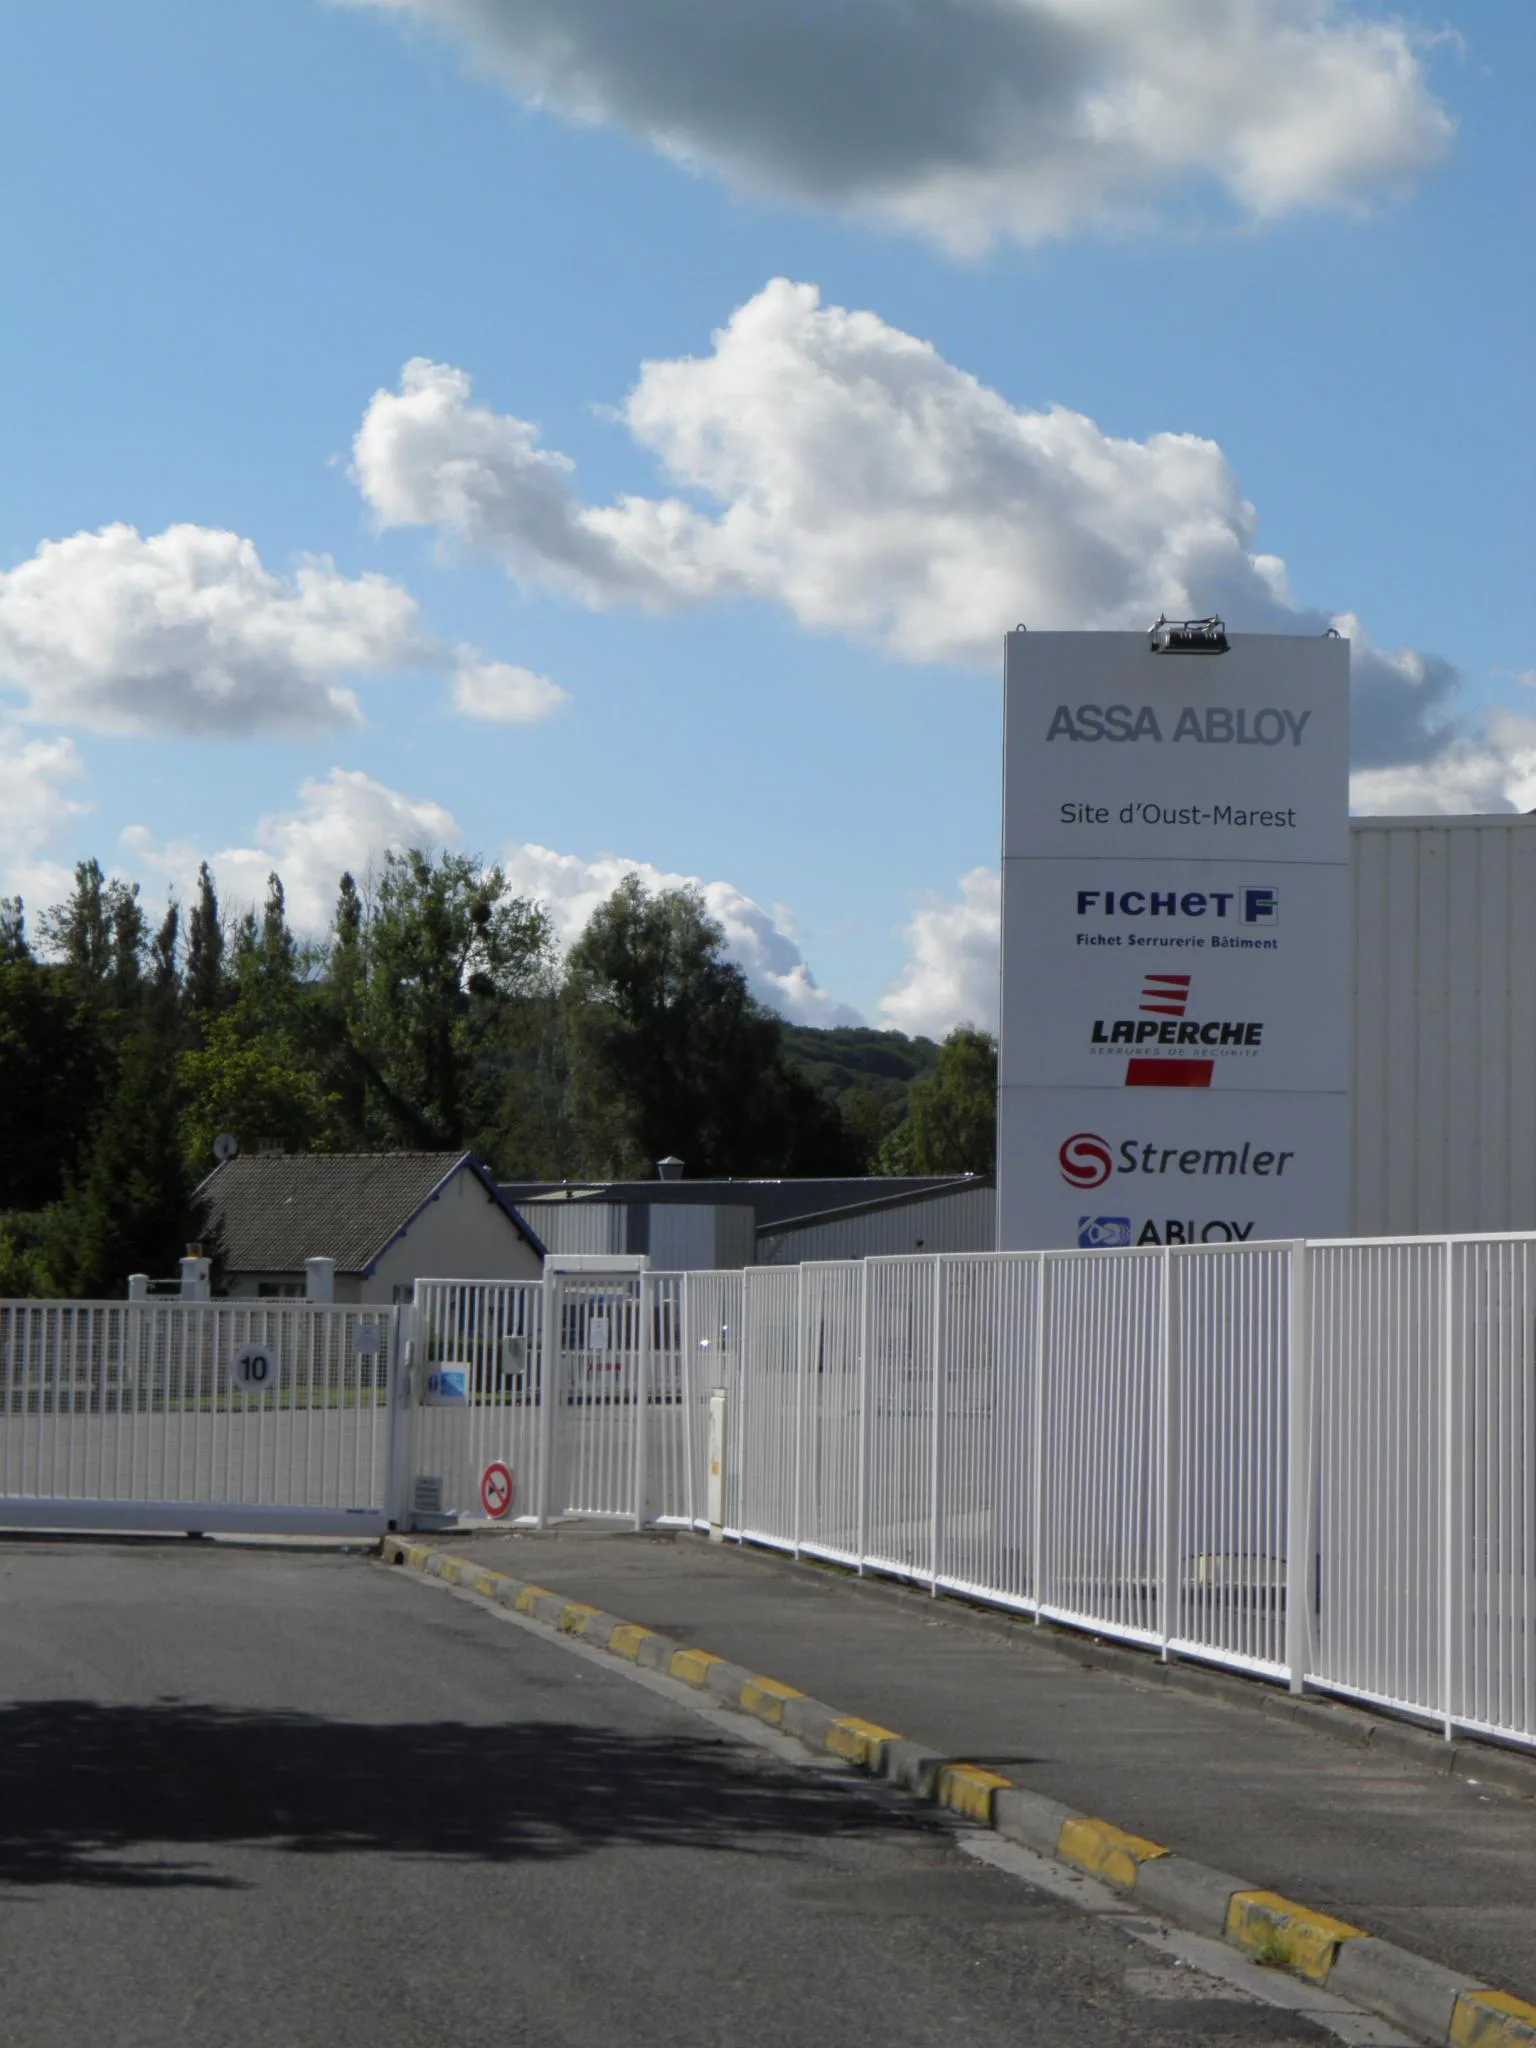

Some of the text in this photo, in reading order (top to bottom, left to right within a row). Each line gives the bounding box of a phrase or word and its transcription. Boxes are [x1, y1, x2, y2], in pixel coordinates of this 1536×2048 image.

[1045, 705, 1312, 746] ASSA ABLOY
[1060, 803, 1297, 827] Site d'Oust-Marest
[1076, 934, 1278, 949] Fichet Serrurerie Bâtiment
[1091, 1020, 1264, 1045] LAPERCHE
[1117, 1140, 1295, 1176] Stremler
[240, 1356, 267, 1381] 10
